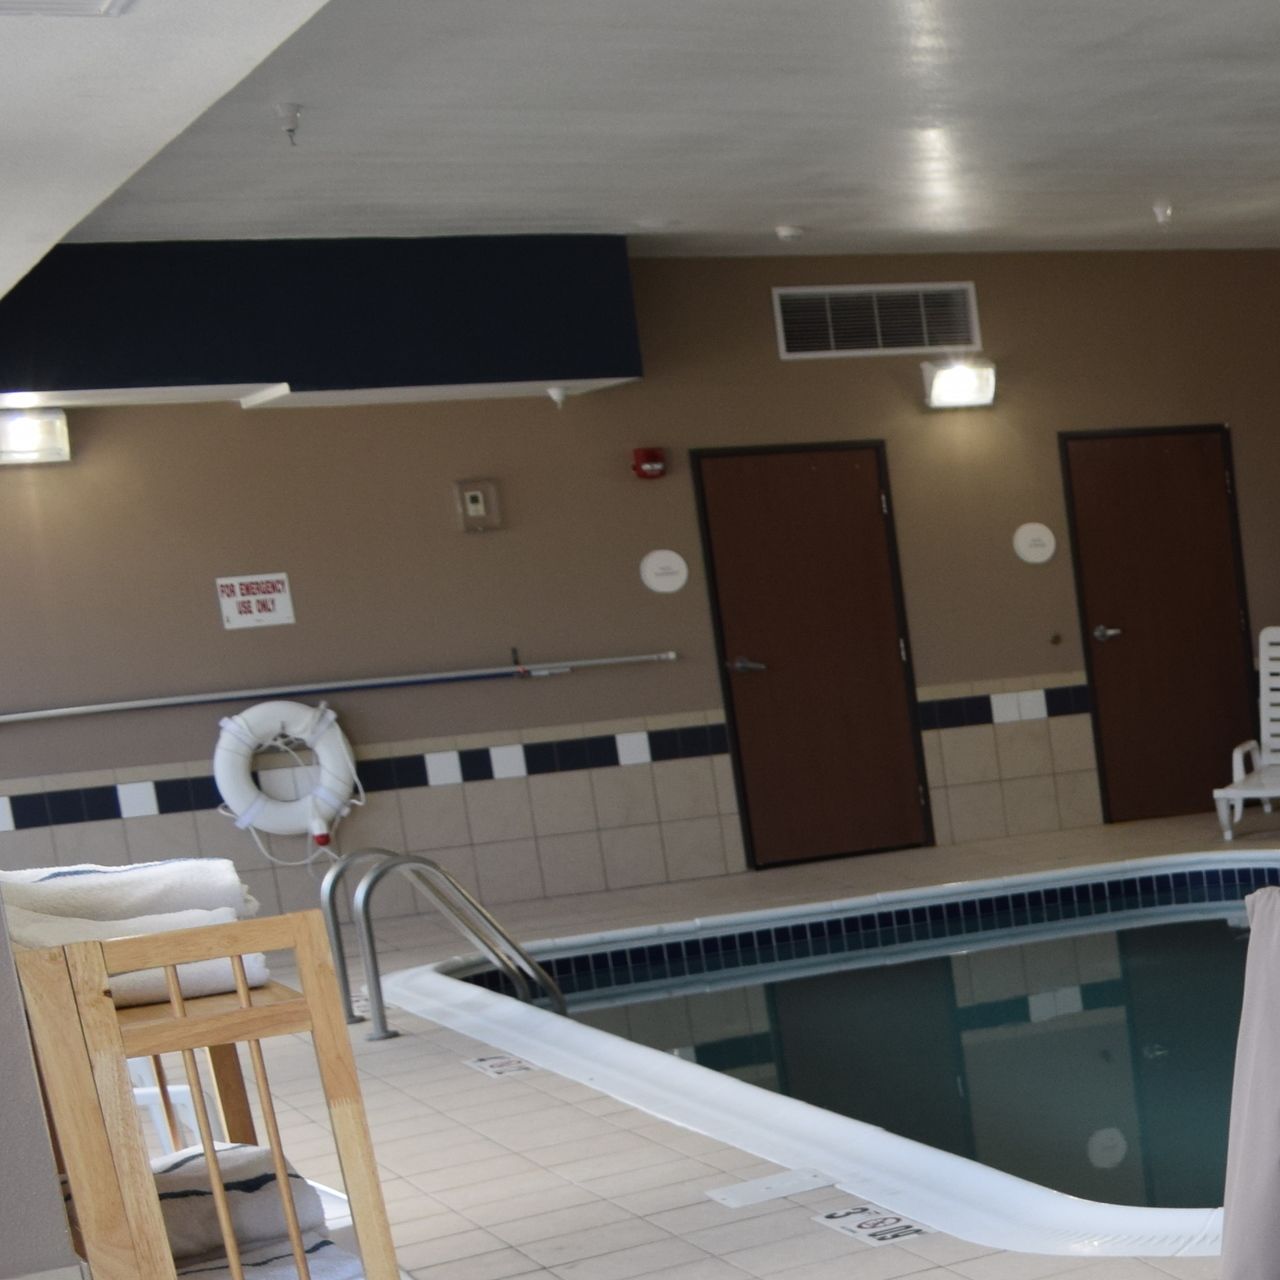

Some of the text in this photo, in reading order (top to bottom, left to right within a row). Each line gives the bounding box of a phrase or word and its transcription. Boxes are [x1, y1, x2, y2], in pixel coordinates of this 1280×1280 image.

[220, 580, 286, 598] FOR EMERGENCY
[237, 598, 275, 615] USE ONLY
